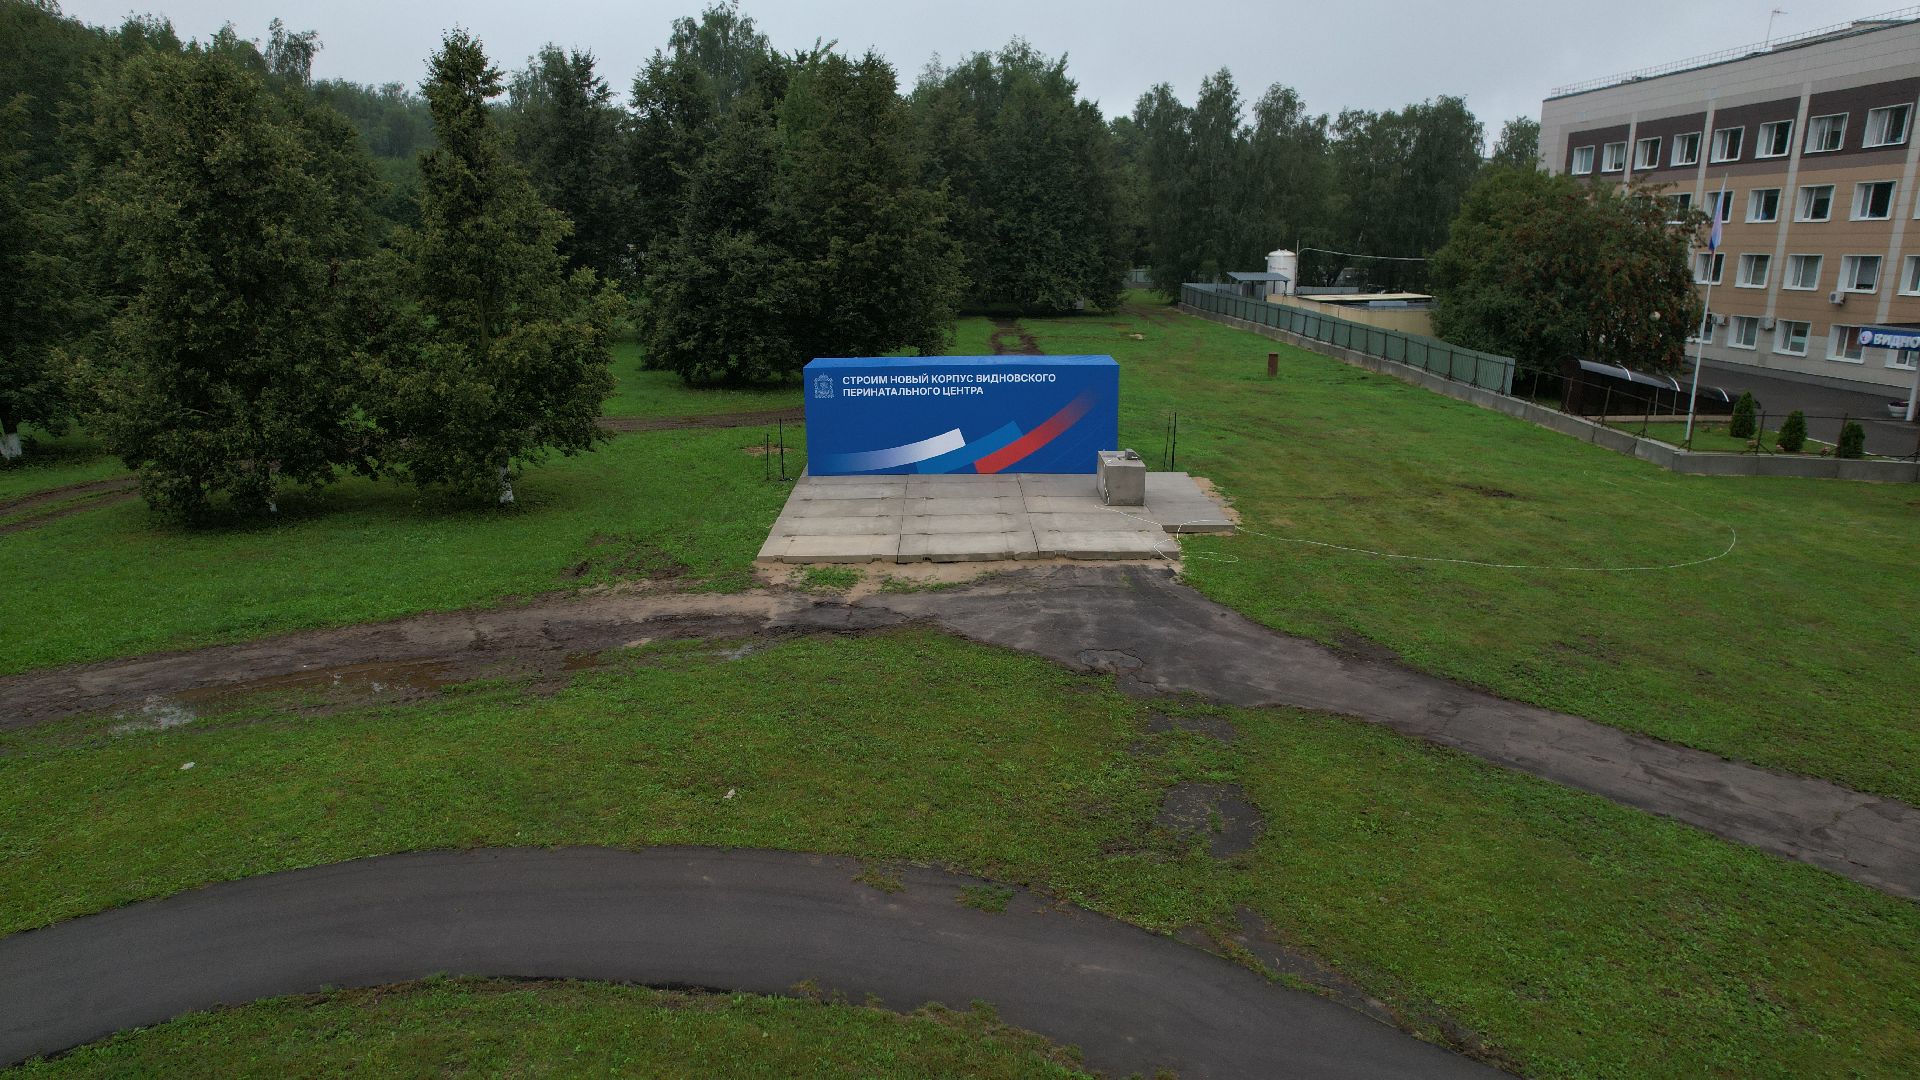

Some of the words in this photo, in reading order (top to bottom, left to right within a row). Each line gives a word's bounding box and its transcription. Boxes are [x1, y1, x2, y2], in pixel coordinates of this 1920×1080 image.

[842, 375, 888, 385] СТРОИМ
[890, 373, 929, 384] НОВЫЙ
[931, 374, 974, 384] КОРПУС
[976, 373, 1056, 384] ВИДНОВСКОГО
[842, 386, 941, 397] ПЕРИНАТАЛЬНОГО
[943, 386, 984, 397] ЦЕНТРА
